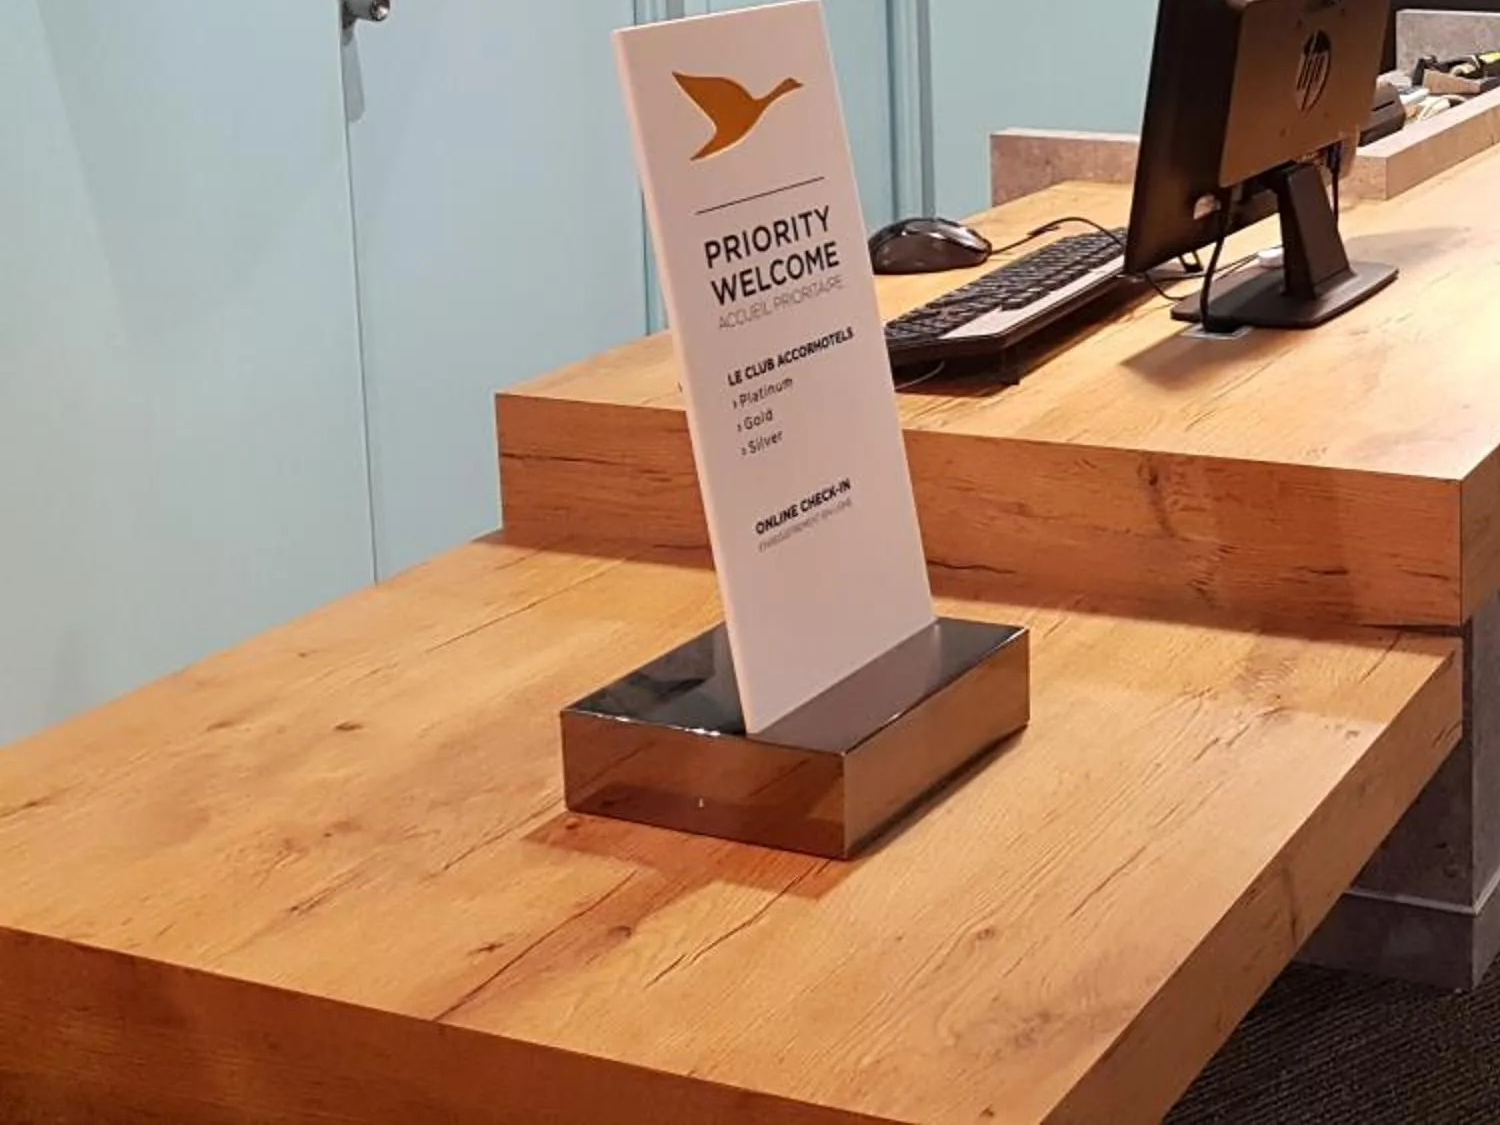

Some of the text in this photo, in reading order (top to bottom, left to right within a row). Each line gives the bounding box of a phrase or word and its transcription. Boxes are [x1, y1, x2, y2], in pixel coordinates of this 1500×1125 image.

[704, 205, 829, 269] PRIORITY
[710, 241, 840, 306] WELCOME
[719, 274, 845, 329] ACCUEIL PRIORITAIRE
[727, 326, 854, 387] LE CLUB ACCORHOTELS
[739, 378, 793, 408] Platinum
[743, 409, 774, 430] Gold
[747, 430, 783, 454] Silver
[755, 504, 799, 535] ONLINE
[800, 478, 851, 513] CHECK-IN
